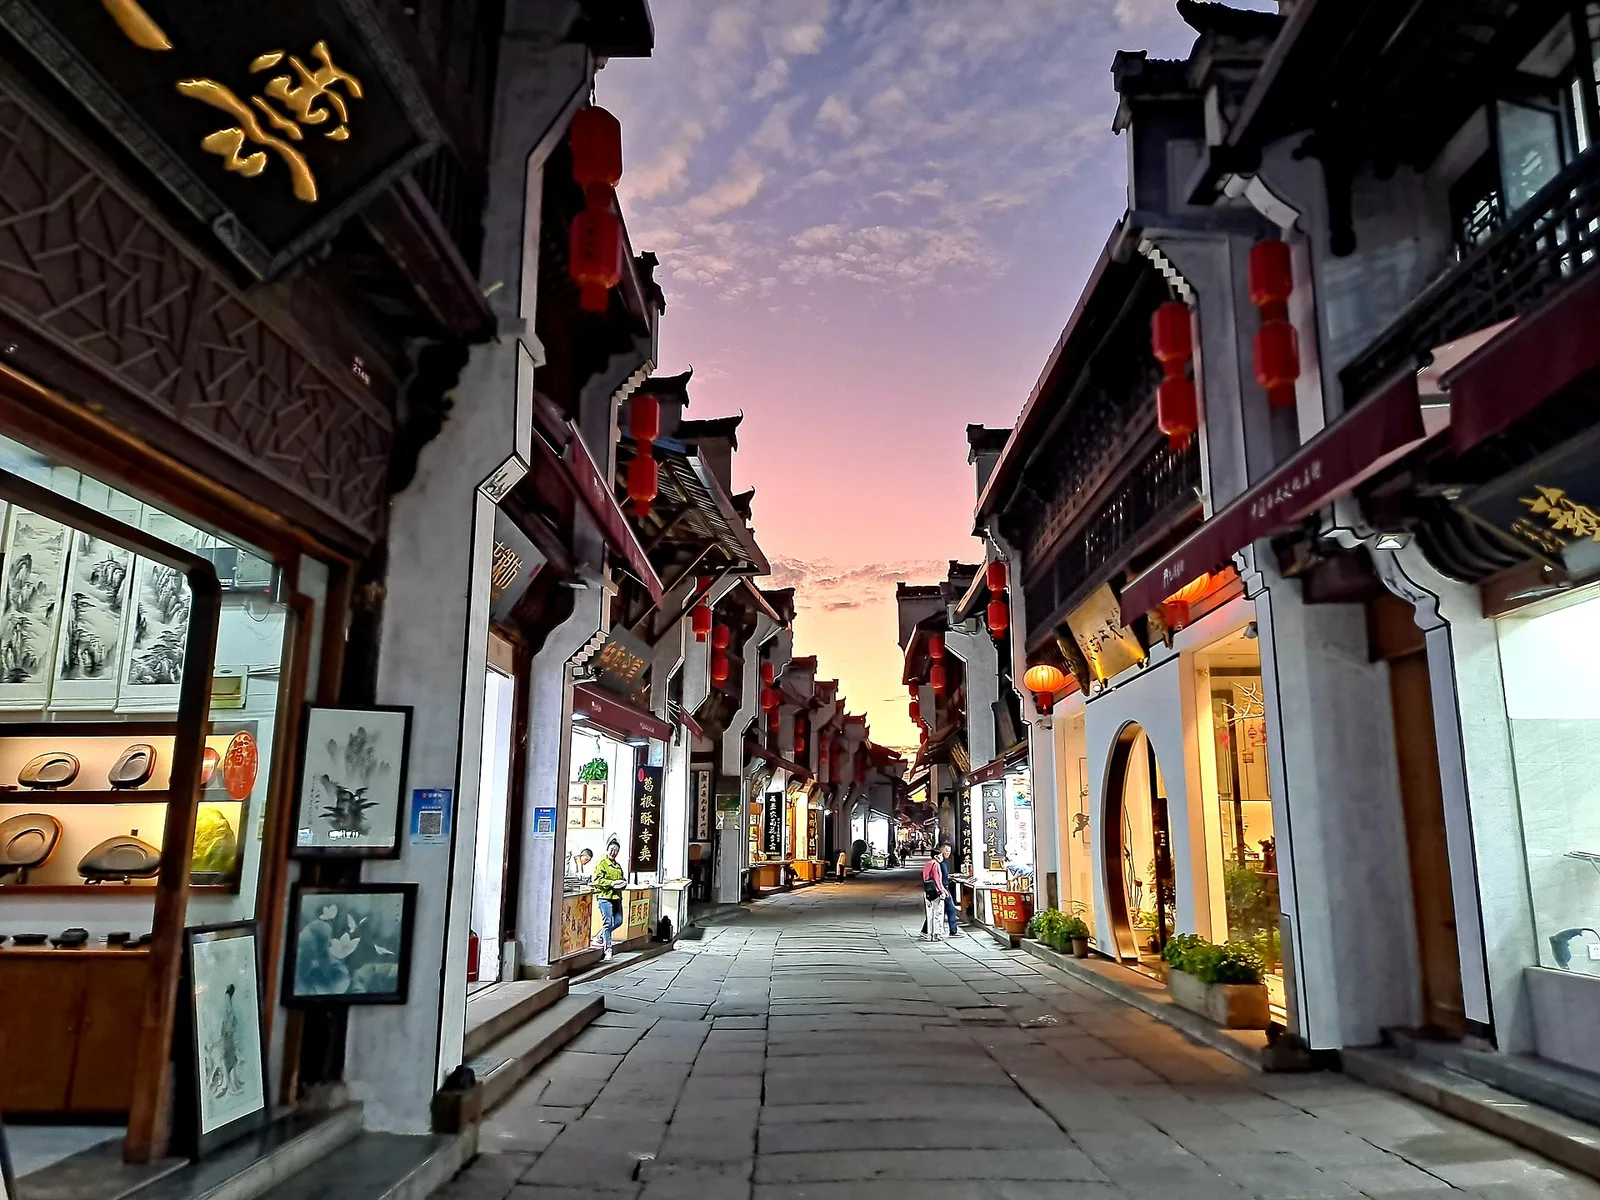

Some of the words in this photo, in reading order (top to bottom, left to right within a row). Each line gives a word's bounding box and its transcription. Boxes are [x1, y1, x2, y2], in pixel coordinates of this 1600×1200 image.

[638, 776, 655, 862] 葛根酥专卖
